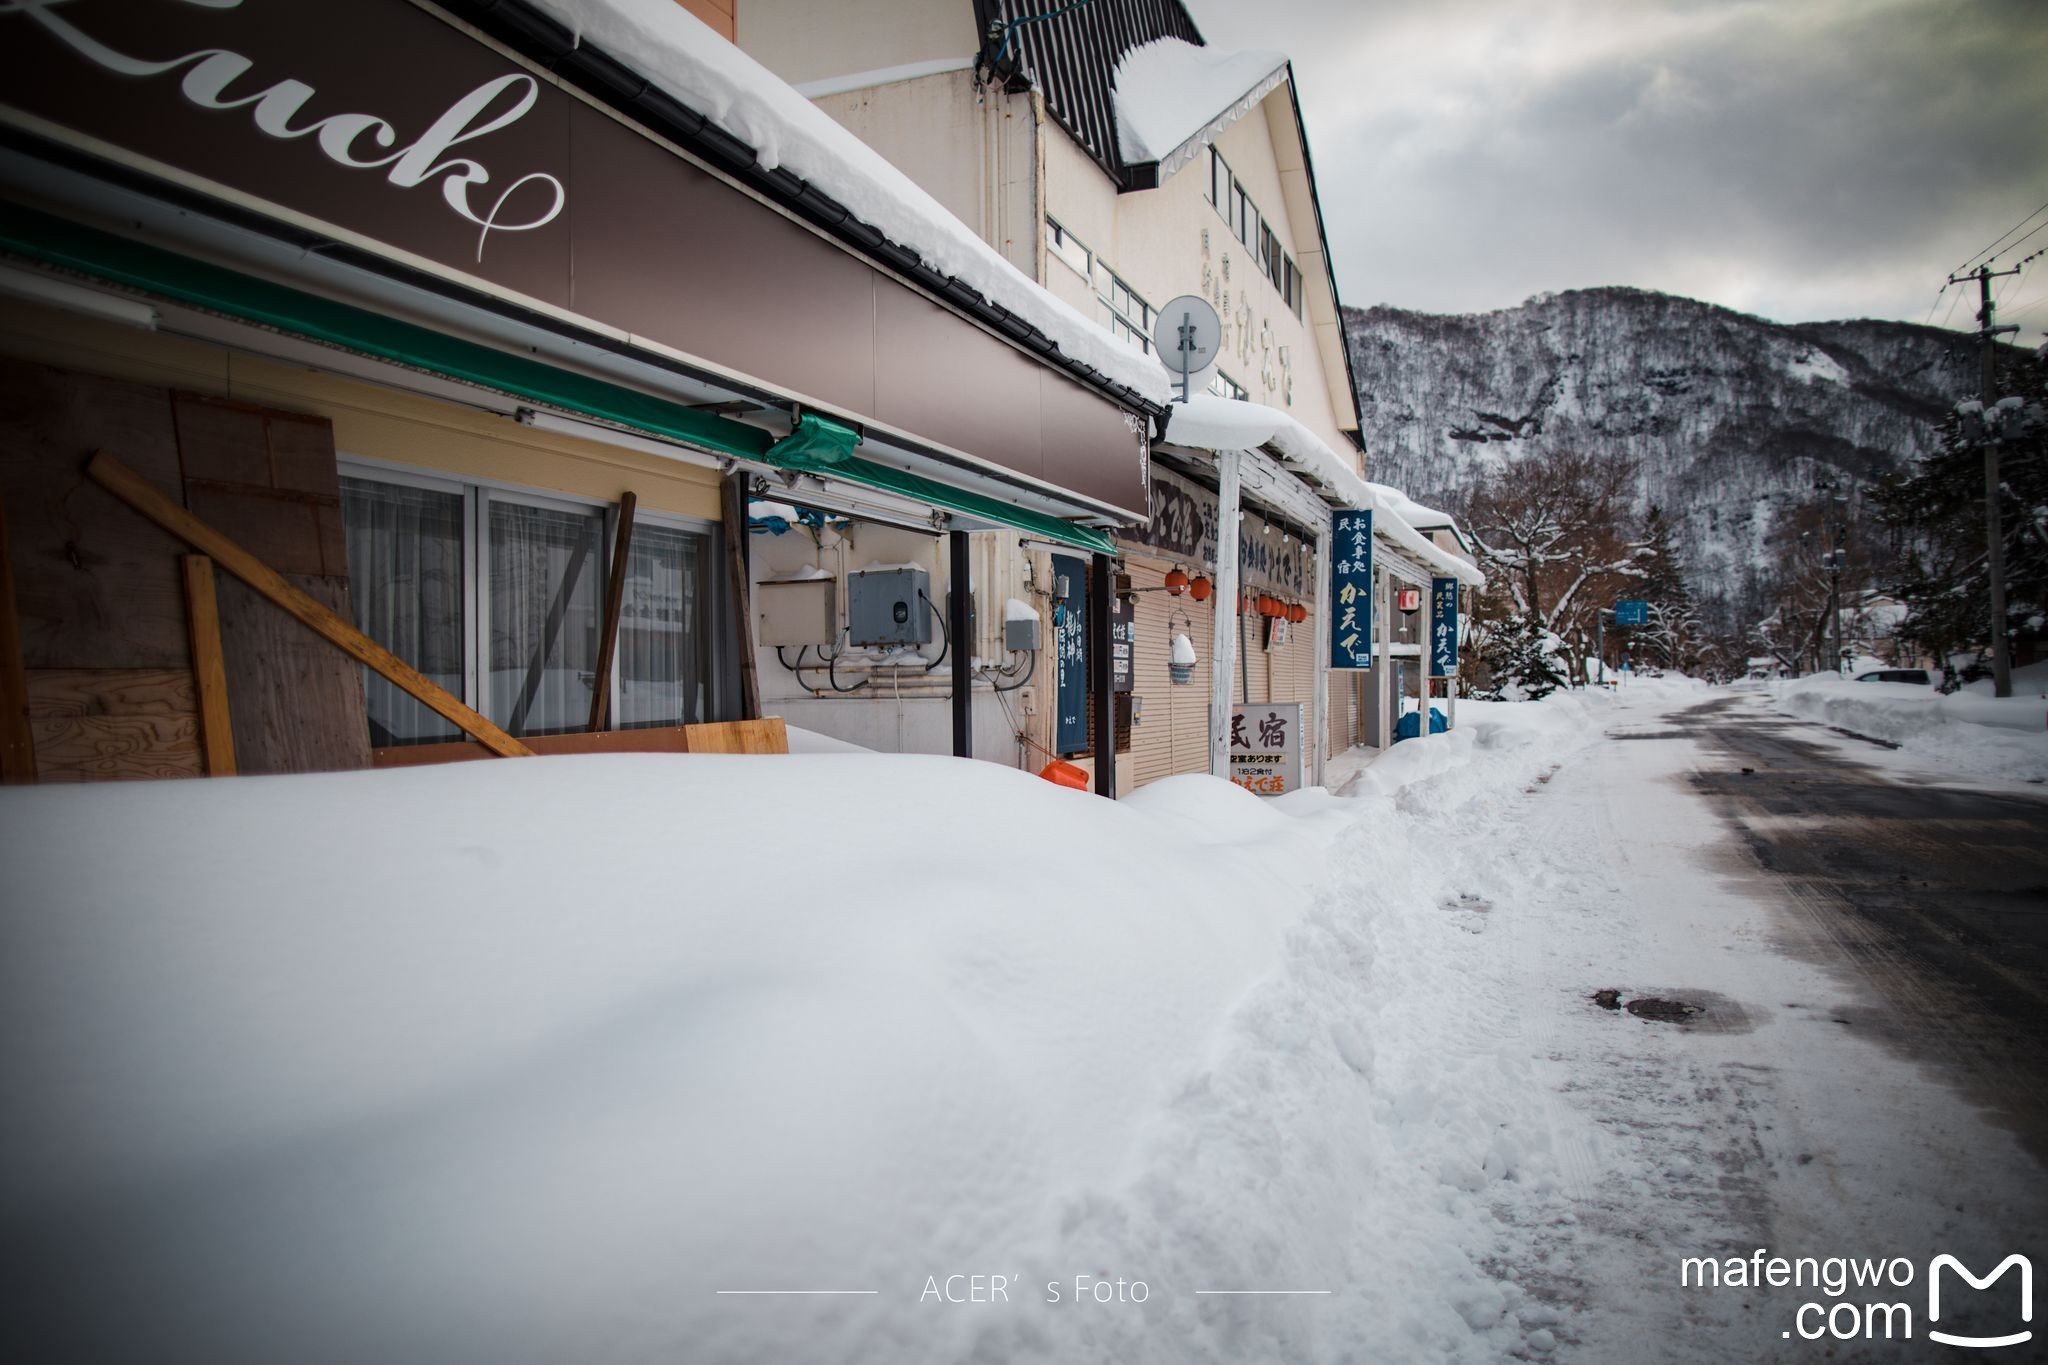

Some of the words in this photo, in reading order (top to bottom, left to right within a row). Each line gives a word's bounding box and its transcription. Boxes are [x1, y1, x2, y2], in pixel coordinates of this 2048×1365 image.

[1337, 517, 1352, 575] 民宿
[1351, 517, 1368, 573] お食事処
[1339, 582, 1367, 660] かえで
[1437, 623, 1455, 669] かえで
[1231, 711, 1288, 750] 民宿
[1230, 754, 1282, 764] 空室あります
[1237, 767, 1273, 776] 1泊2食付
